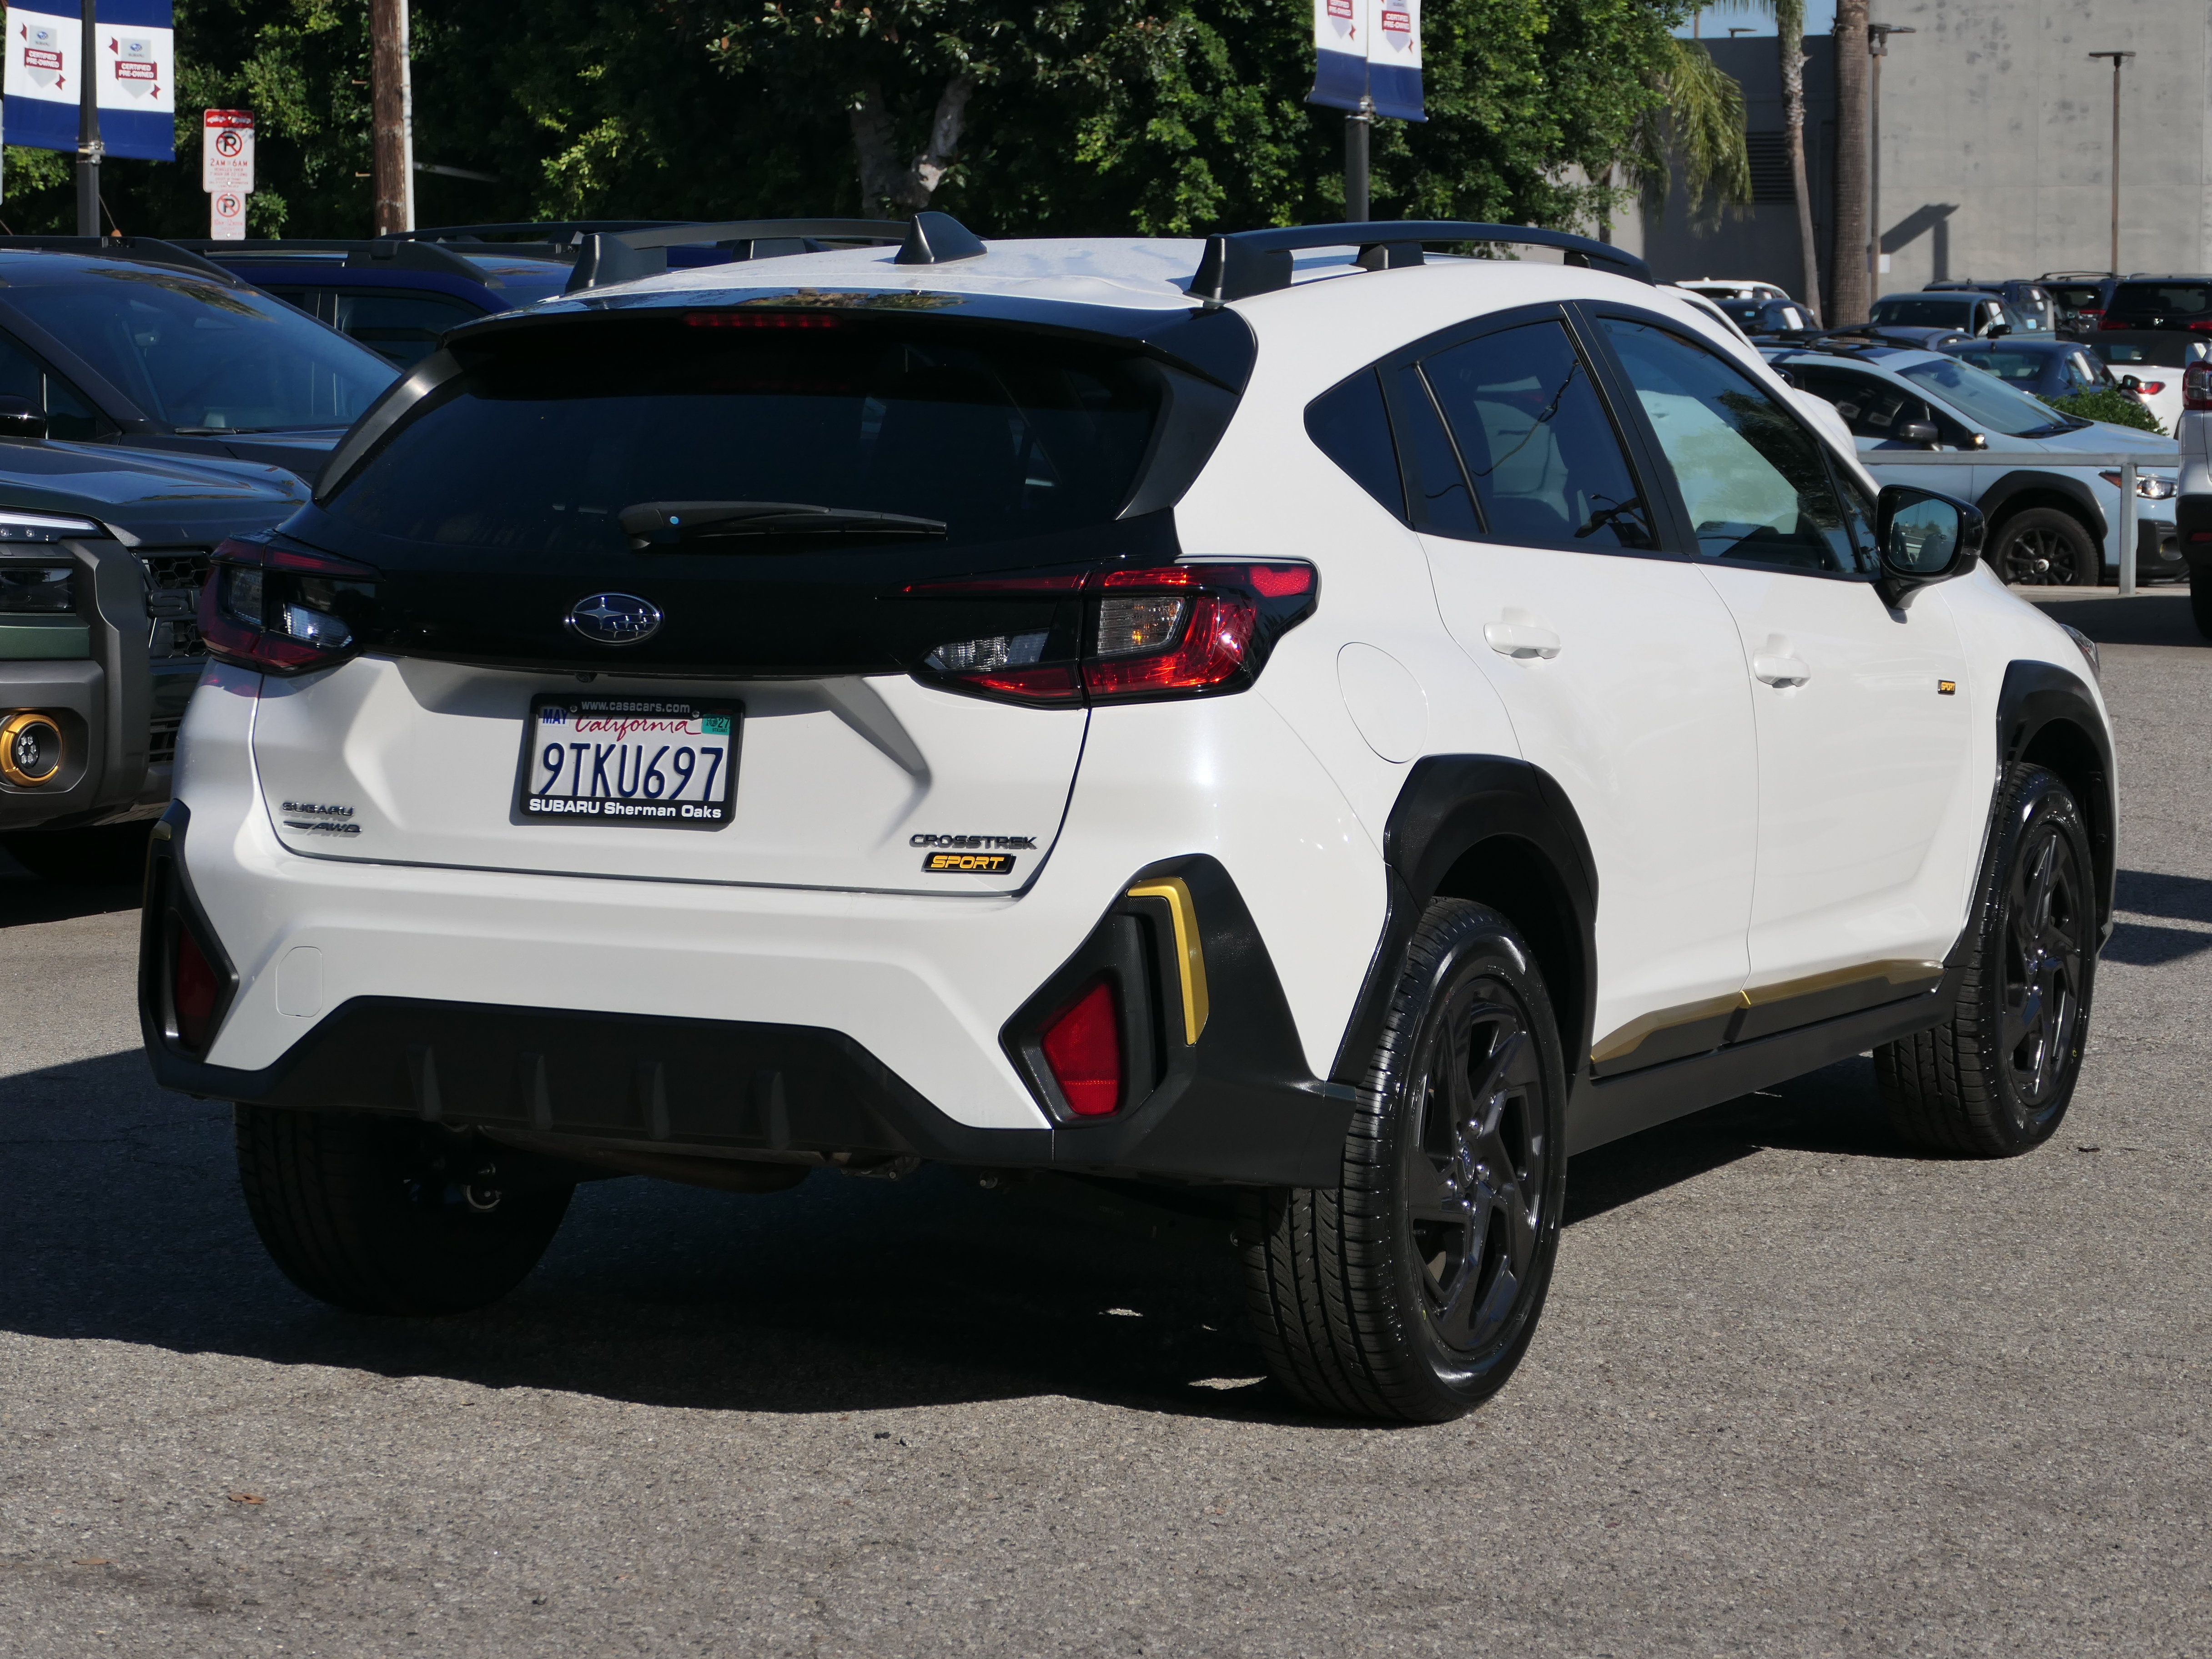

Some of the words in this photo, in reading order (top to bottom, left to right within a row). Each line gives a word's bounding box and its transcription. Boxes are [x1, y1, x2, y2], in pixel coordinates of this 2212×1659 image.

[29, 50, 57, 60] CERTIFIED
[26, 56, 60, 68] PRE-OWNED
[121, 63, 151, 71] CERTIFIED
[118, 70, 154, 78] PRE-OWNED
[210, 158, 226, 166] 2AM
[581, 701, 690, 713] www.casacars.com
[543, 709, 568, 724] MAY
[718, 717, 730, 728] 27
[575, 715, 701, 742] California
[538, 743, 724, 801] 9TKU697
[282, 802, 355, 816] SUBARU
[529, 799, 599, 814] SUBARU
[604, 802, 676, 817] Sherman
[681, 805, 722, 819] Oaks
[312, 822, 362, 833] AWD
[910, 834, 1037, 849] CROSSTREK
[930, 855, 1005, 869] SPORT
